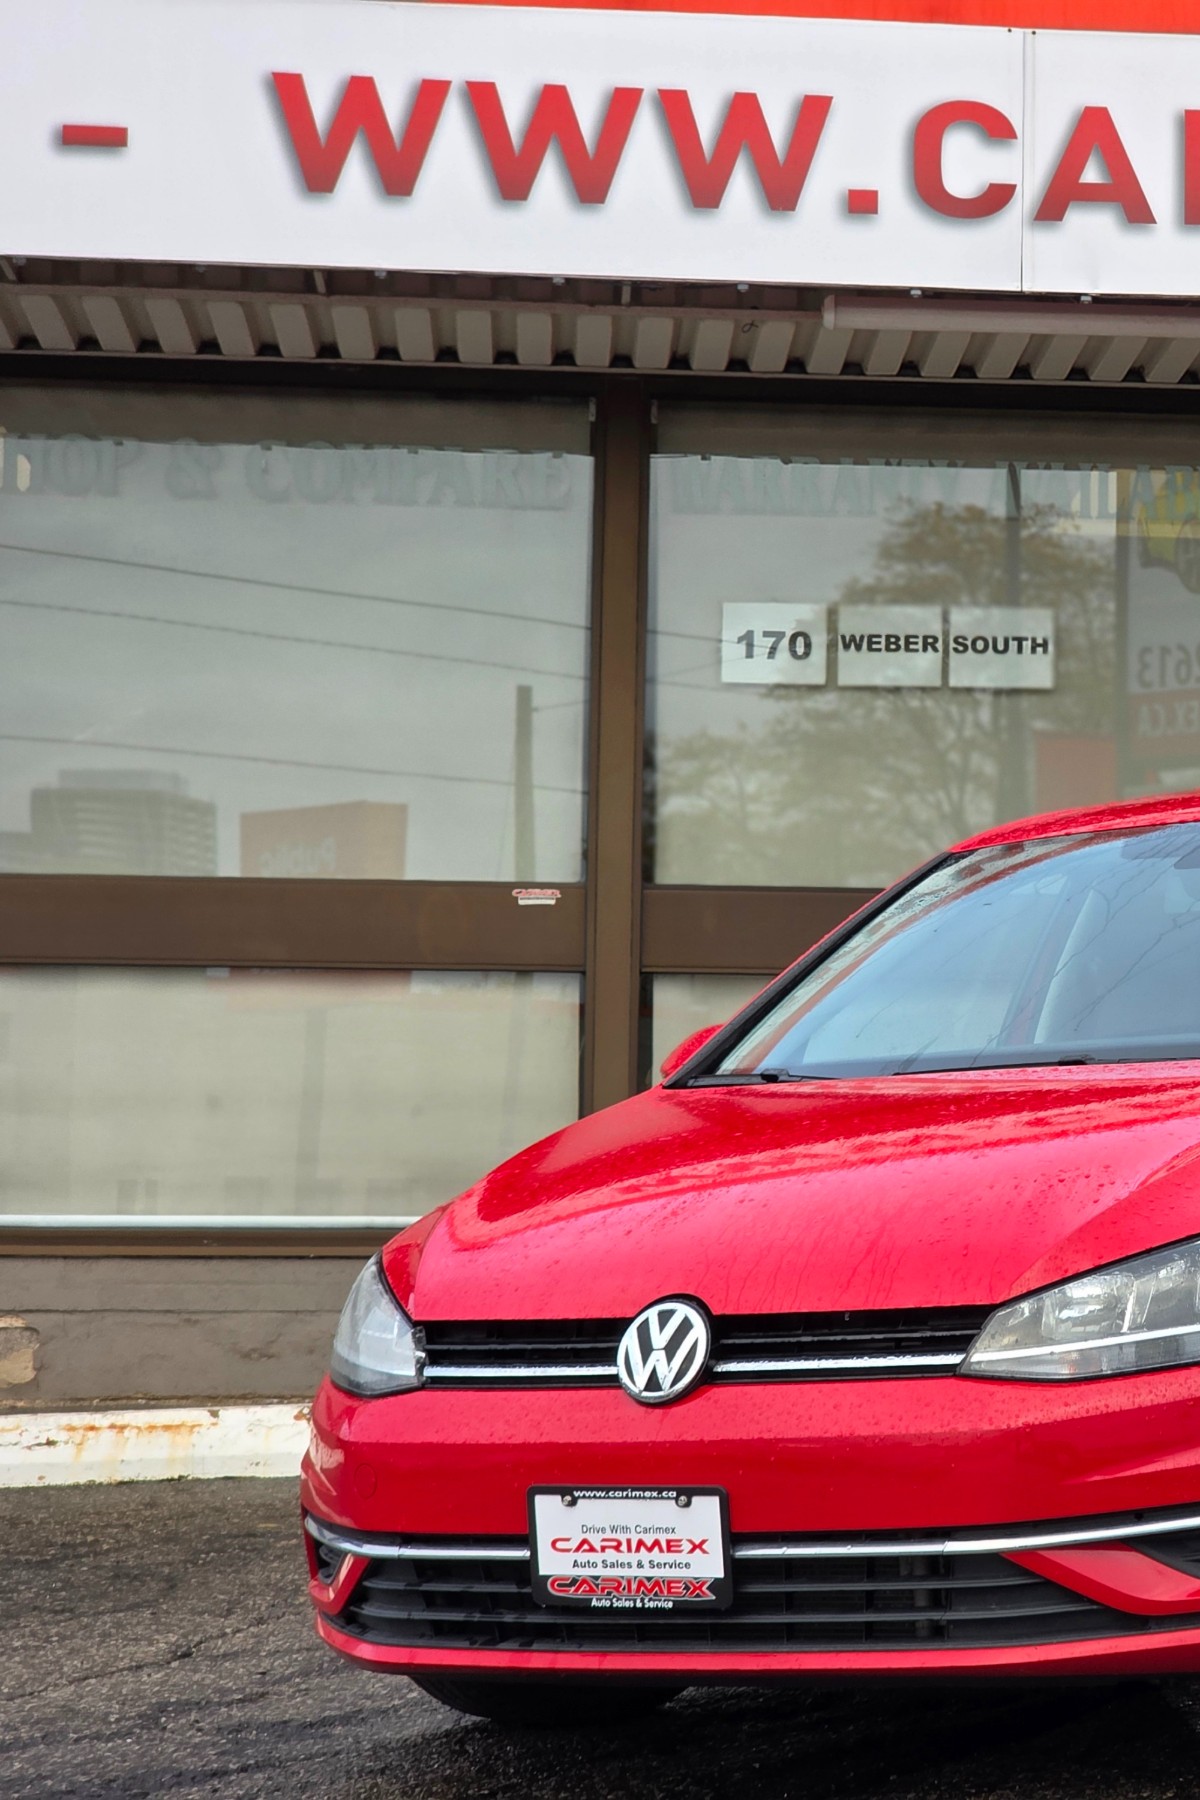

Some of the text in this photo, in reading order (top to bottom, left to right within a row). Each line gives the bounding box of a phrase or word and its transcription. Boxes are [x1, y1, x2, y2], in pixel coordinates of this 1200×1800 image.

[736, 630, 812, 660] 170
[839, 633, 940, 653] WEBER
[952, 635, 1049, 655] SOUTH
[573, 1489, 677, 1499] www.carimex.ca
[581, 1524, 677, 1535] Drive With Carimex
[550, 1537, 710, 1555] CARIMEX
[572, 1559, 692, 1570] Auto Sales & Service
[548, 1576, 715, 1600] CARIMEX
[591, 1598, 673, 1609] Auto Sales & Service
